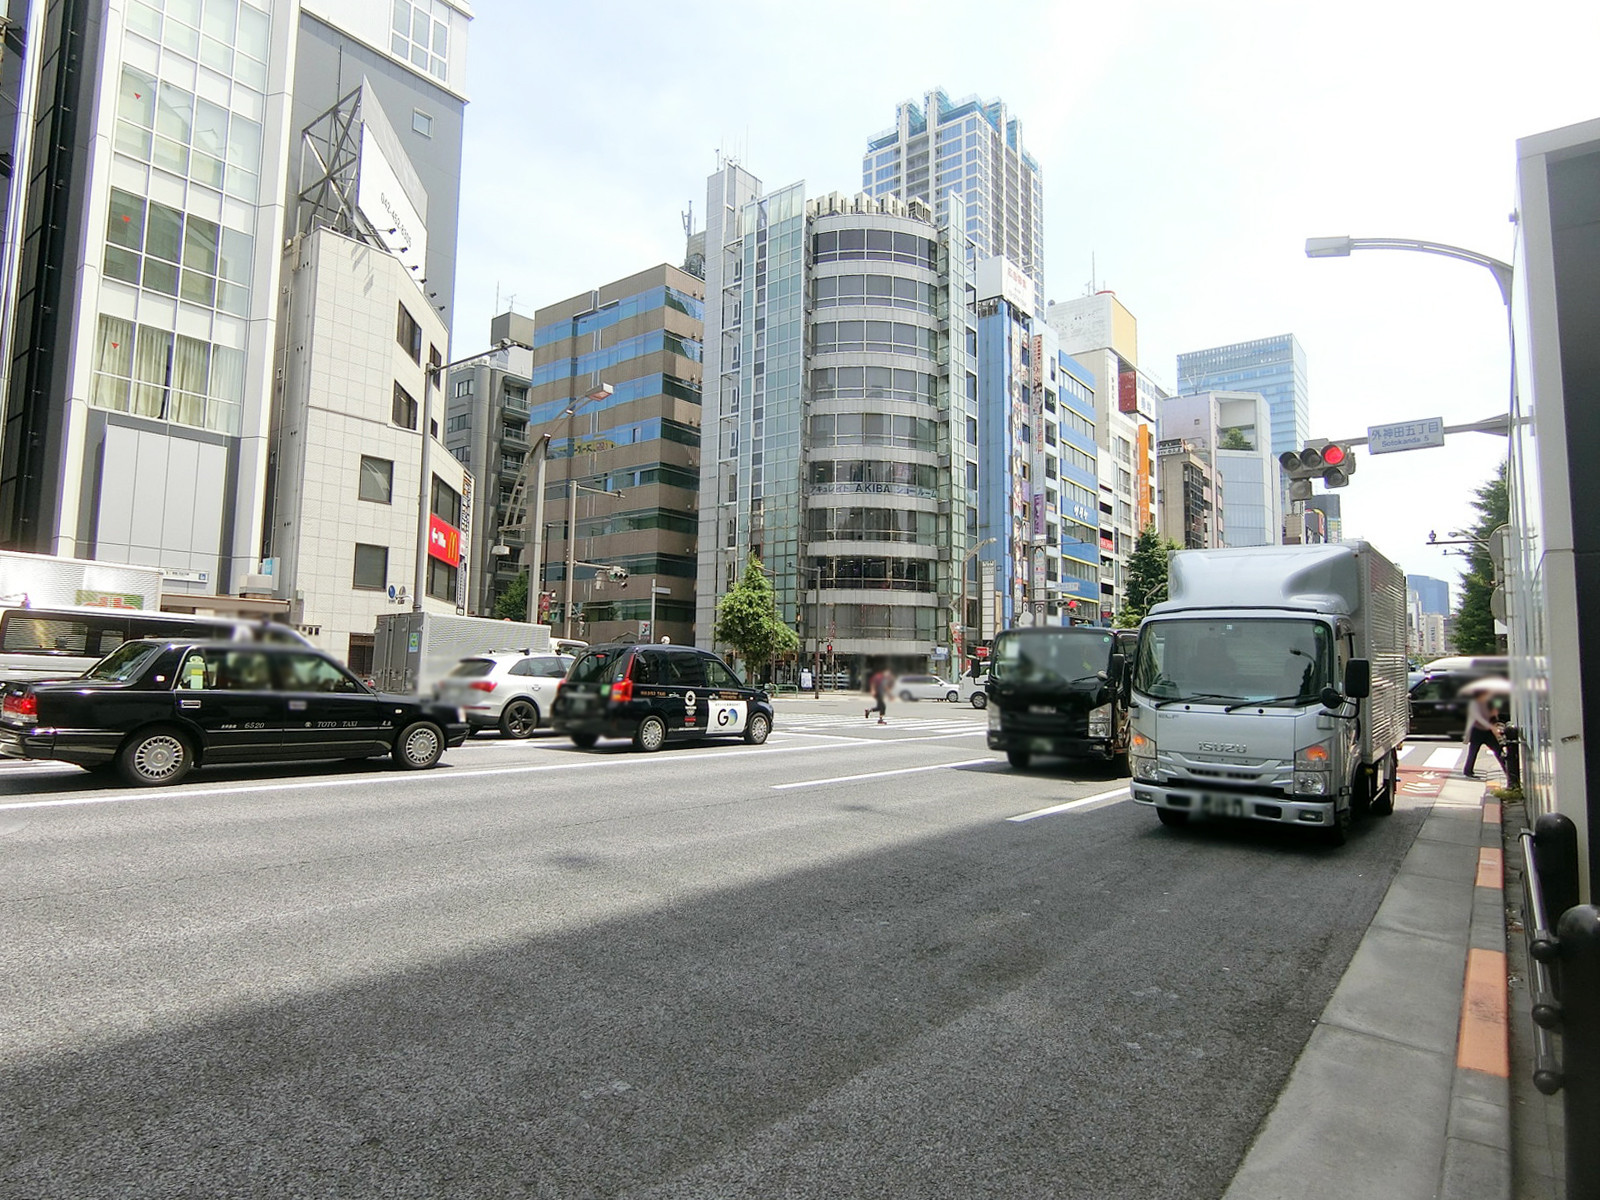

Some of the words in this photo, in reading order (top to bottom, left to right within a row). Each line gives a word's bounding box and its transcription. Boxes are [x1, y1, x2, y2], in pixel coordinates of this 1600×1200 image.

[1371, 421, 1439, 441] 外神田五丁目
[1381, 437, 1421, 448] Sotokanda
[855, 483, 891, 493] AKIBA
[895, 486, 937, 498] ショールーム
[317, 720, 337, 728] TOTO
[717, 708, 739, 727] GO
[244, 721, 265, 729] 6520
[1198, 741, 1248, 754] ISUZU
